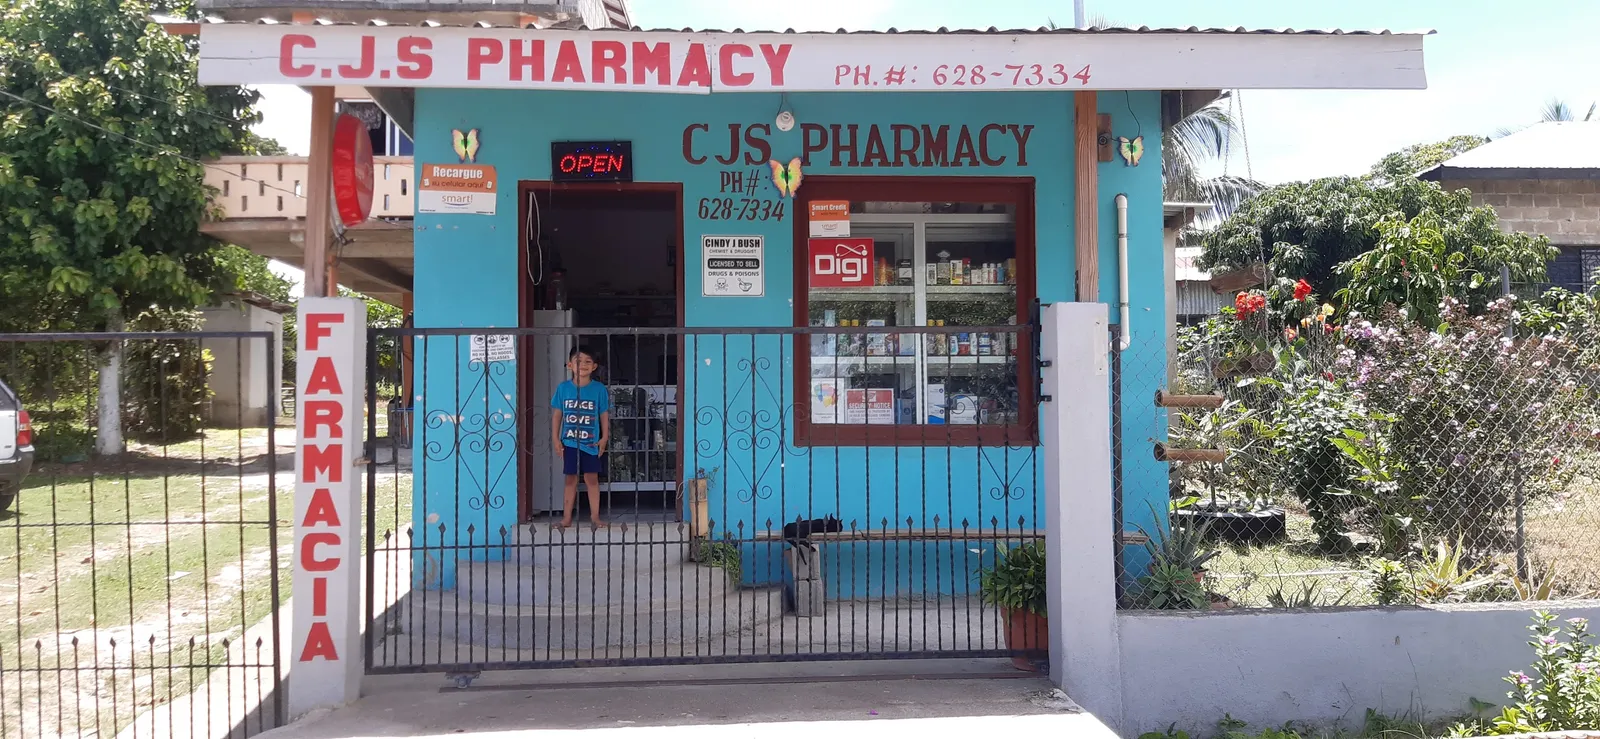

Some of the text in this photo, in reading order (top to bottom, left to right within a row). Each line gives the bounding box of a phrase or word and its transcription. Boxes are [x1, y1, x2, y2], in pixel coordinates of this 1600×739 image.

[279, 34, 793, 87] C.J.S PHARMACY
[932, 63, 1091, 86] 628-7334
[800, 123, 1035, 168] PHARMACY
[433, 166, 483, 179] Recargue
[560, 155, 624, 173] OPEN
[442, 194, 473, 203] smart!
[829, 203, 847, 211] Credit
[698, 198, 785, 223] 628-7334
[705, 238, 761, 248] CINDY J BUSH
[815, 249, 868, 282] Digi
[566, 415, 590, 424] LOVE
[299, 313, 344, 662] FARMACIA
